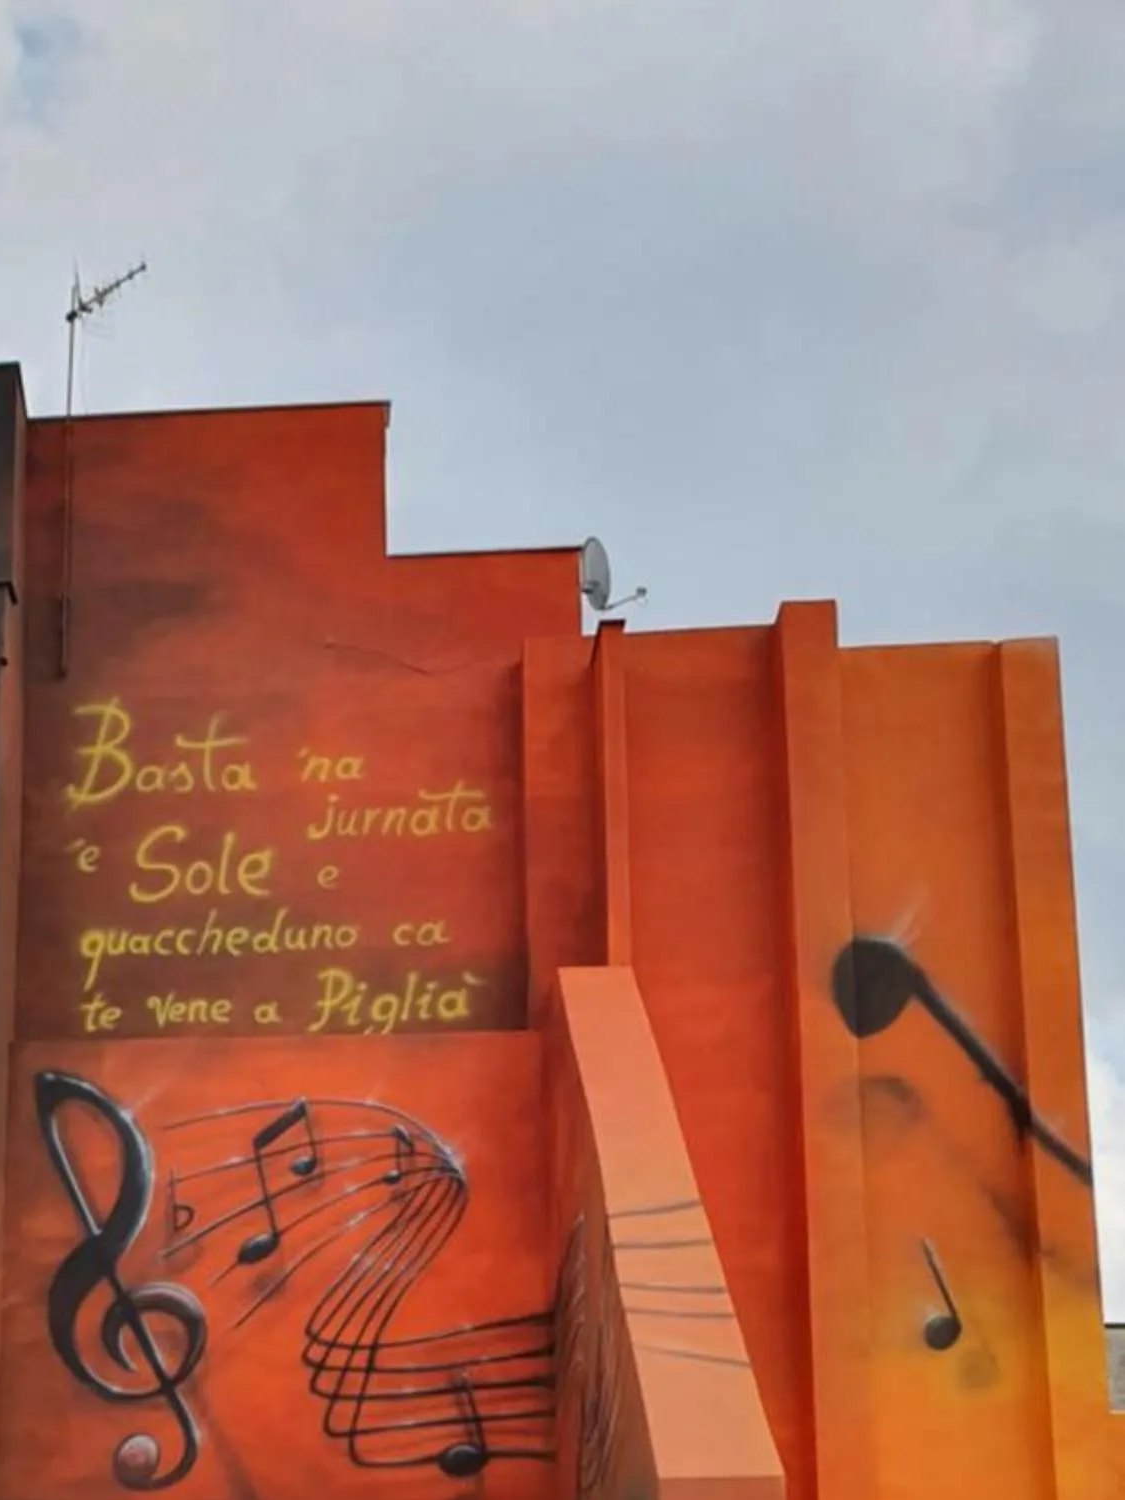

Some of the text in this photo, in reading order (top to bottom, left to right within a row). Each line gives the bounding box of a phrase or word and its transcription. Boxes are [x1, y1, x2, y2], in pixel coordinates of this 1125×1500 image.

[68, 697, 258, 808] Basta
[129, 825, 273, 902] Sole
[317, 864, 339, 889] e
[80, 908, 451, 992] quaccheduno ca
[253, 1001, 282, 1024] a
